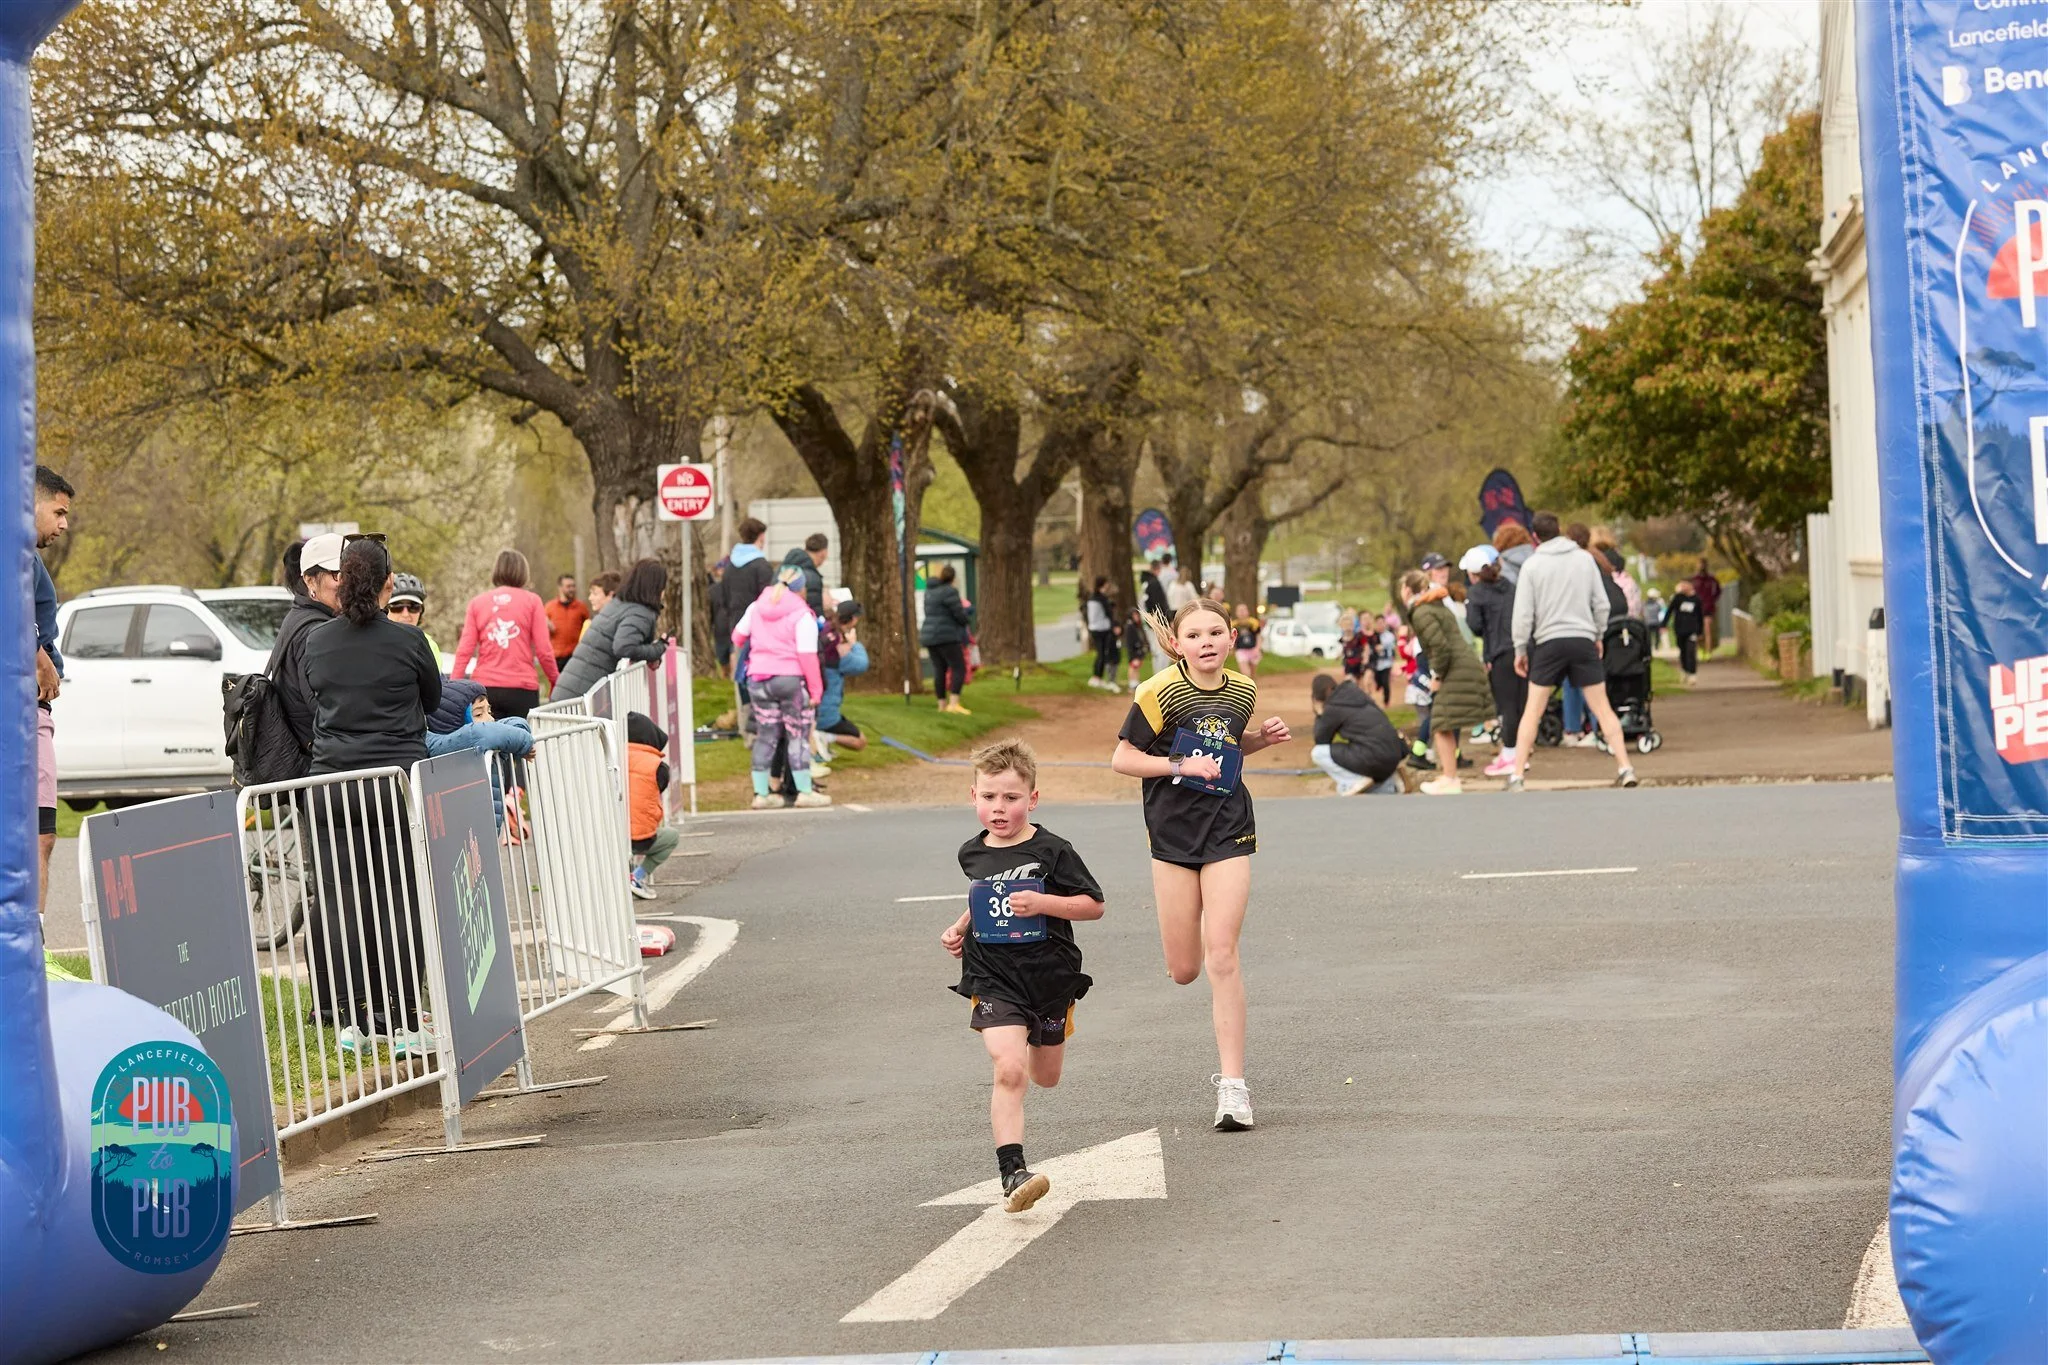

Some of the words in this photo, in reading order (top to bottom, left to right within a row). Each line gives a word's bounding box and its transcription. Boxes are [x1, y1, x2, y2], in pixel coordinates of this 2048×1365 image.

[676, 472, 695, 486] NO
[666, 498, 706, 513] ENTRY
[988, 896, 1015, 918] 36
[995, 919, 1009, 927] JEZ
[177, 941, 190, 964] THE
[207, 975, 247, 1028] HOTEL
